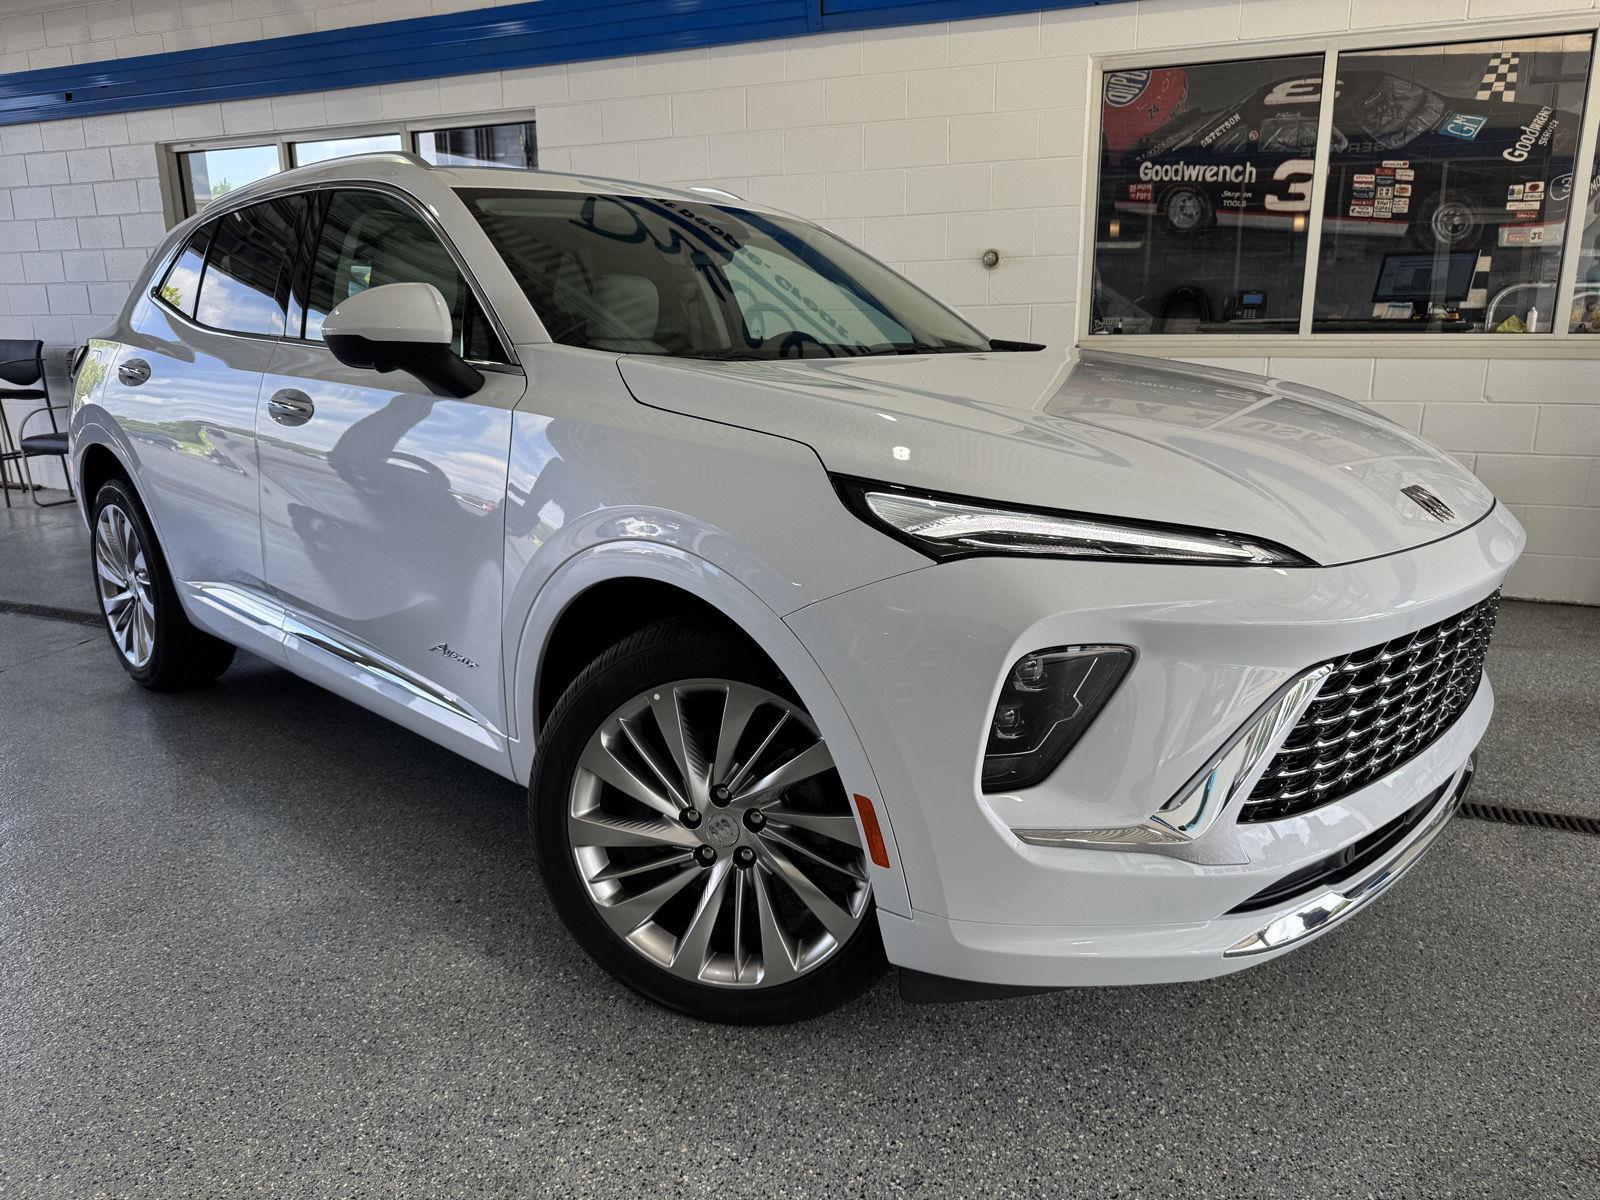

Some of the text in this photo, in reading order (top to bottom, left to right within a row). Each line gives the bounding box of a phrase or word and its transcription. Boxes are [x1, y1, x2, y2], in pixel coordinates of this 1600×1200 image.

[1538, 119, 1560, 147] SERVICE
[1139, 161, 1257, 184] Goodwrench
[1264, 159, 1316, 212] 3
[1222, 200, 1247, 208] TOOLS
